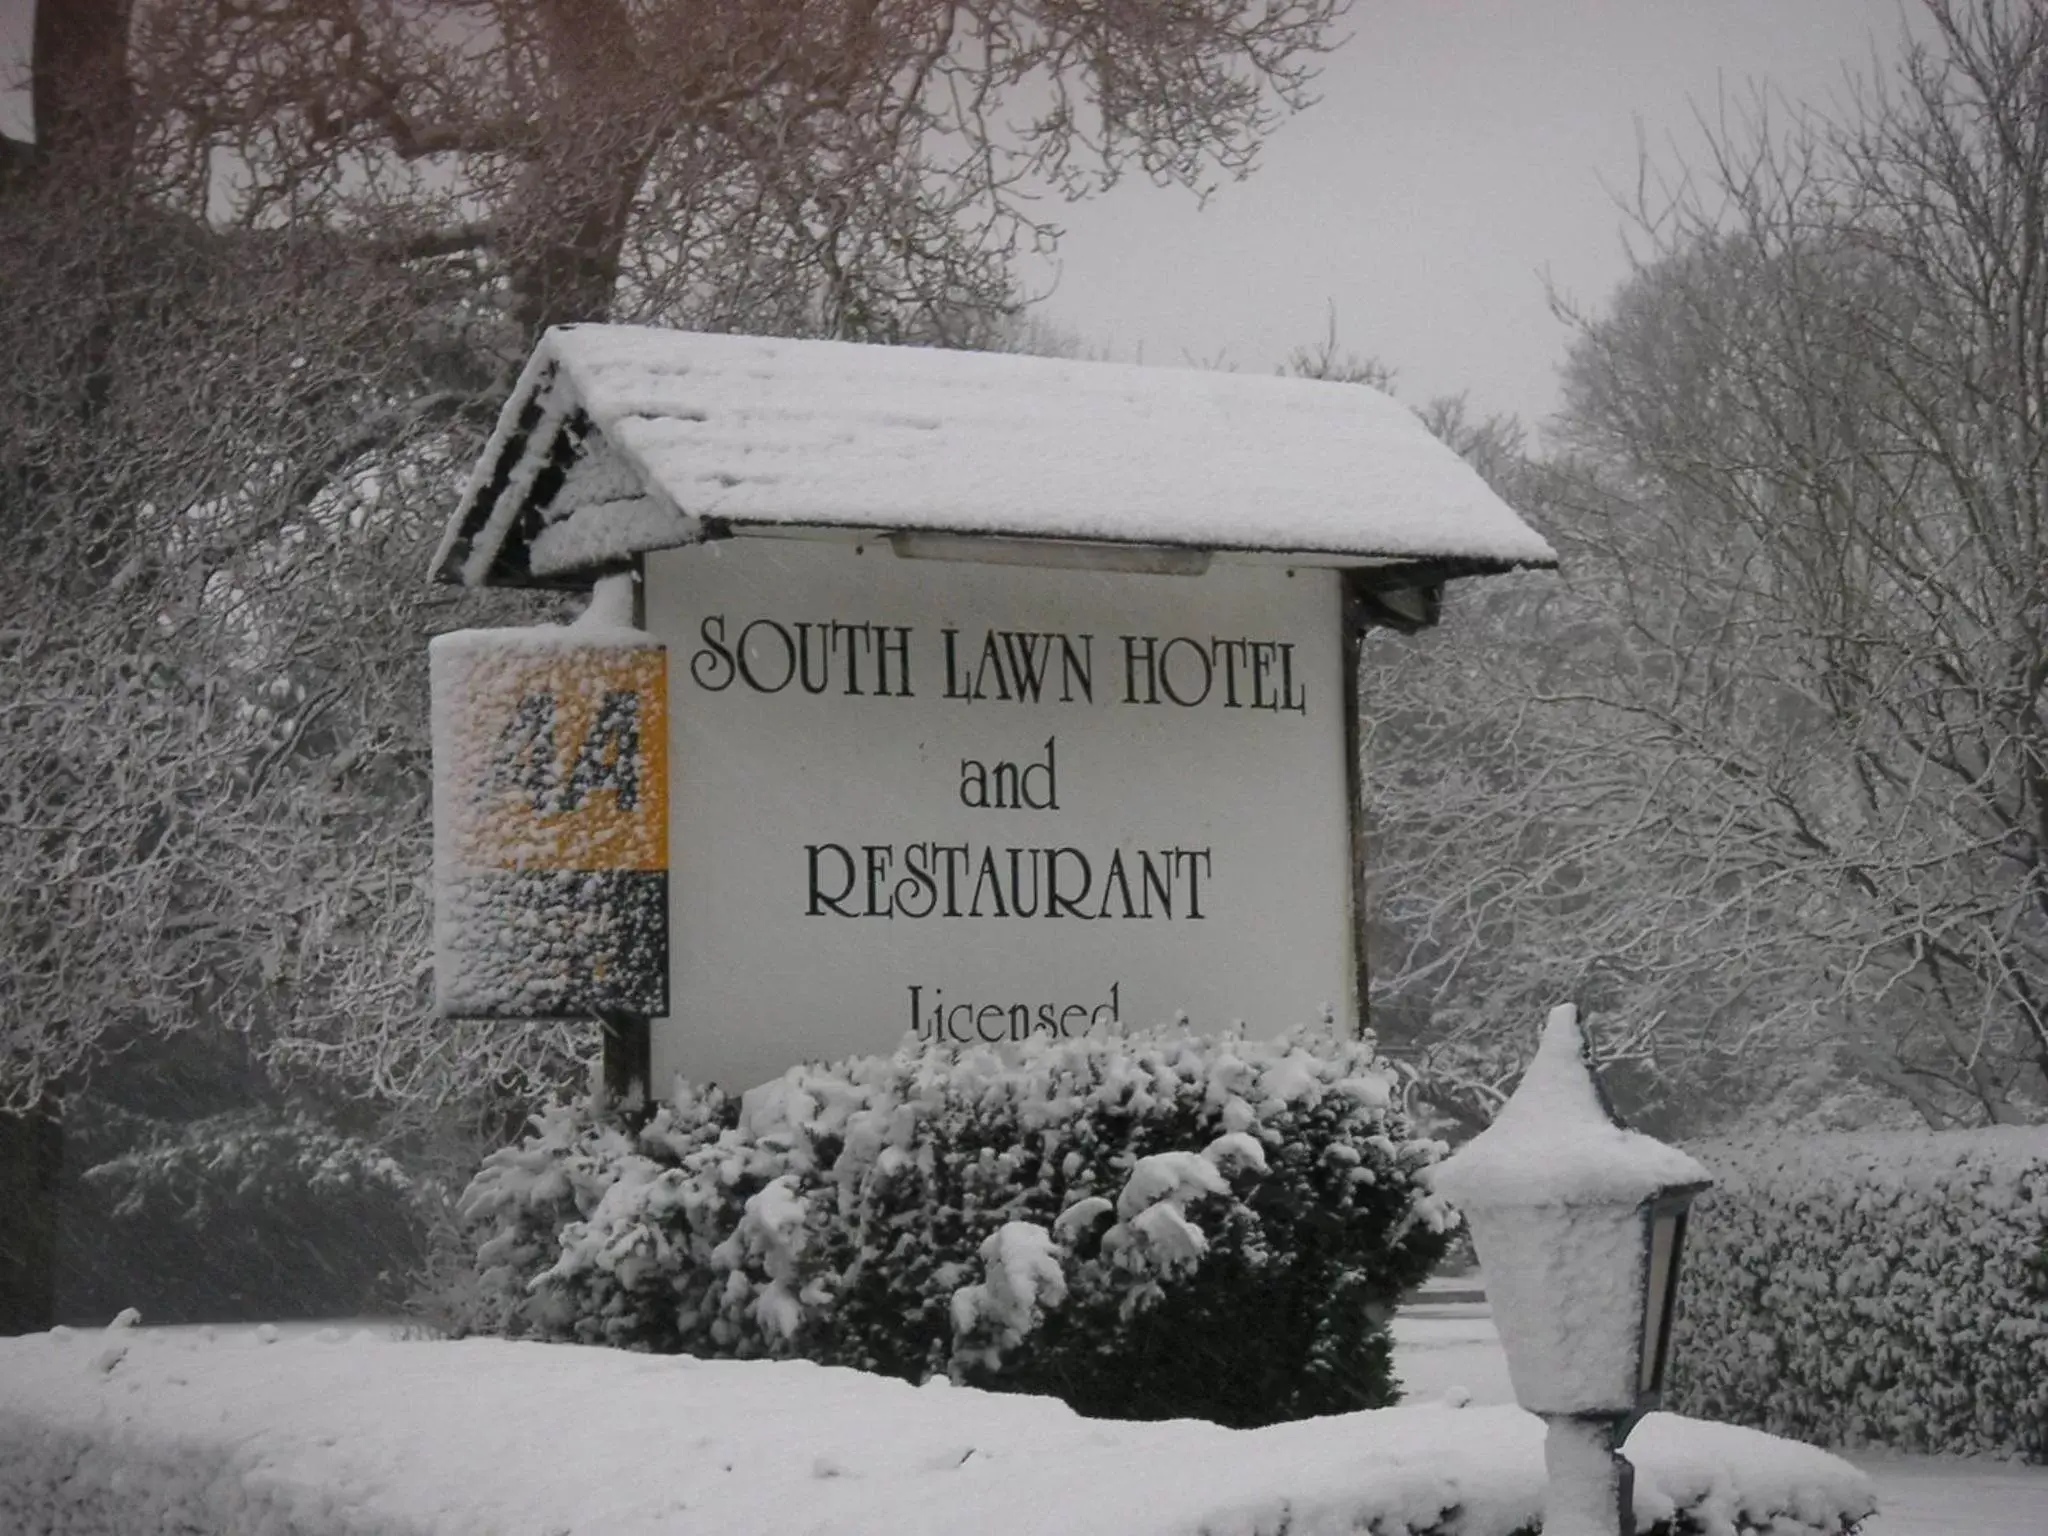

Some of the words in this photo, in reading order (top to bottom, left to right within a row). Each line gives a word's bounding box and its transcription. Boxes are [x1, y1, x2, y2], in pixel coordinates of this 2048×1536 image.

[690, 613, 915, 697] SOUTH
[940, 628, 1094, 706] LAWN
[1118, 635, 1308, 717] HOTEL
[960, 734, 1060, 810] and
[804, 841, 1211, 920] RESTAURANT
[907, 981, 1119, 1044] Licensed
